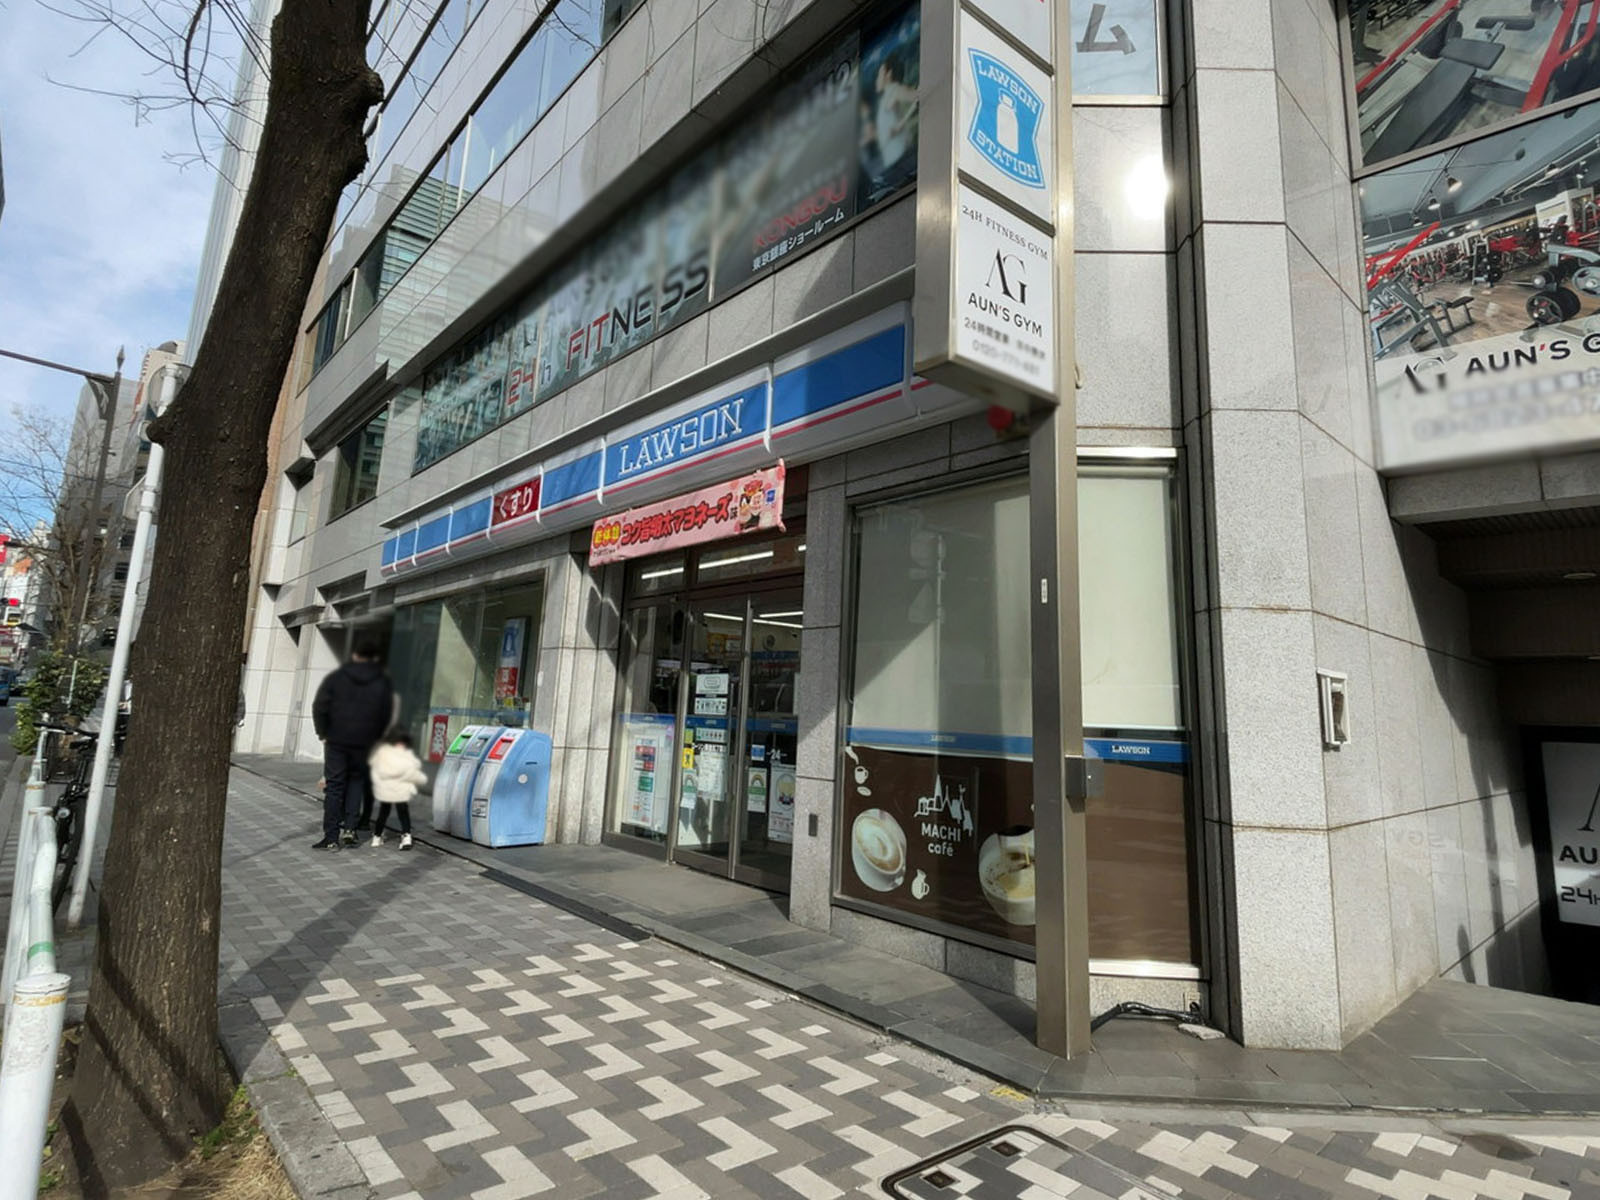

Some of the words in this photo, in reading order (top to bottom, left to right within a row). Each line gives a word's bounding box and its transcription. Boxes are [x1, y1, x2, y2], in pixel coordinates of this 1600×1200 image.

[977, 60, 1038, 114] LAWSON
[975, 129, 1038, 179] STATION
[961, 205, 983, 222] 24H
[985, 215, 1026, 247] FITNESS
[1028, 241, 1048, 260] GYM
[565, 250, 710, 370] FITNESS
[968, 292, 1010, 322] AUN'S
[1013, 313, 1043, 337] GYM
[1465, 340, 1571, 376] AUN'S
[618, 398, 744, 475] LAWSON
[500, 486, 533, 519] くすり
[1111, 744, 1151, 755] LAWSON
[921, 821, 961, 842] MACHI
